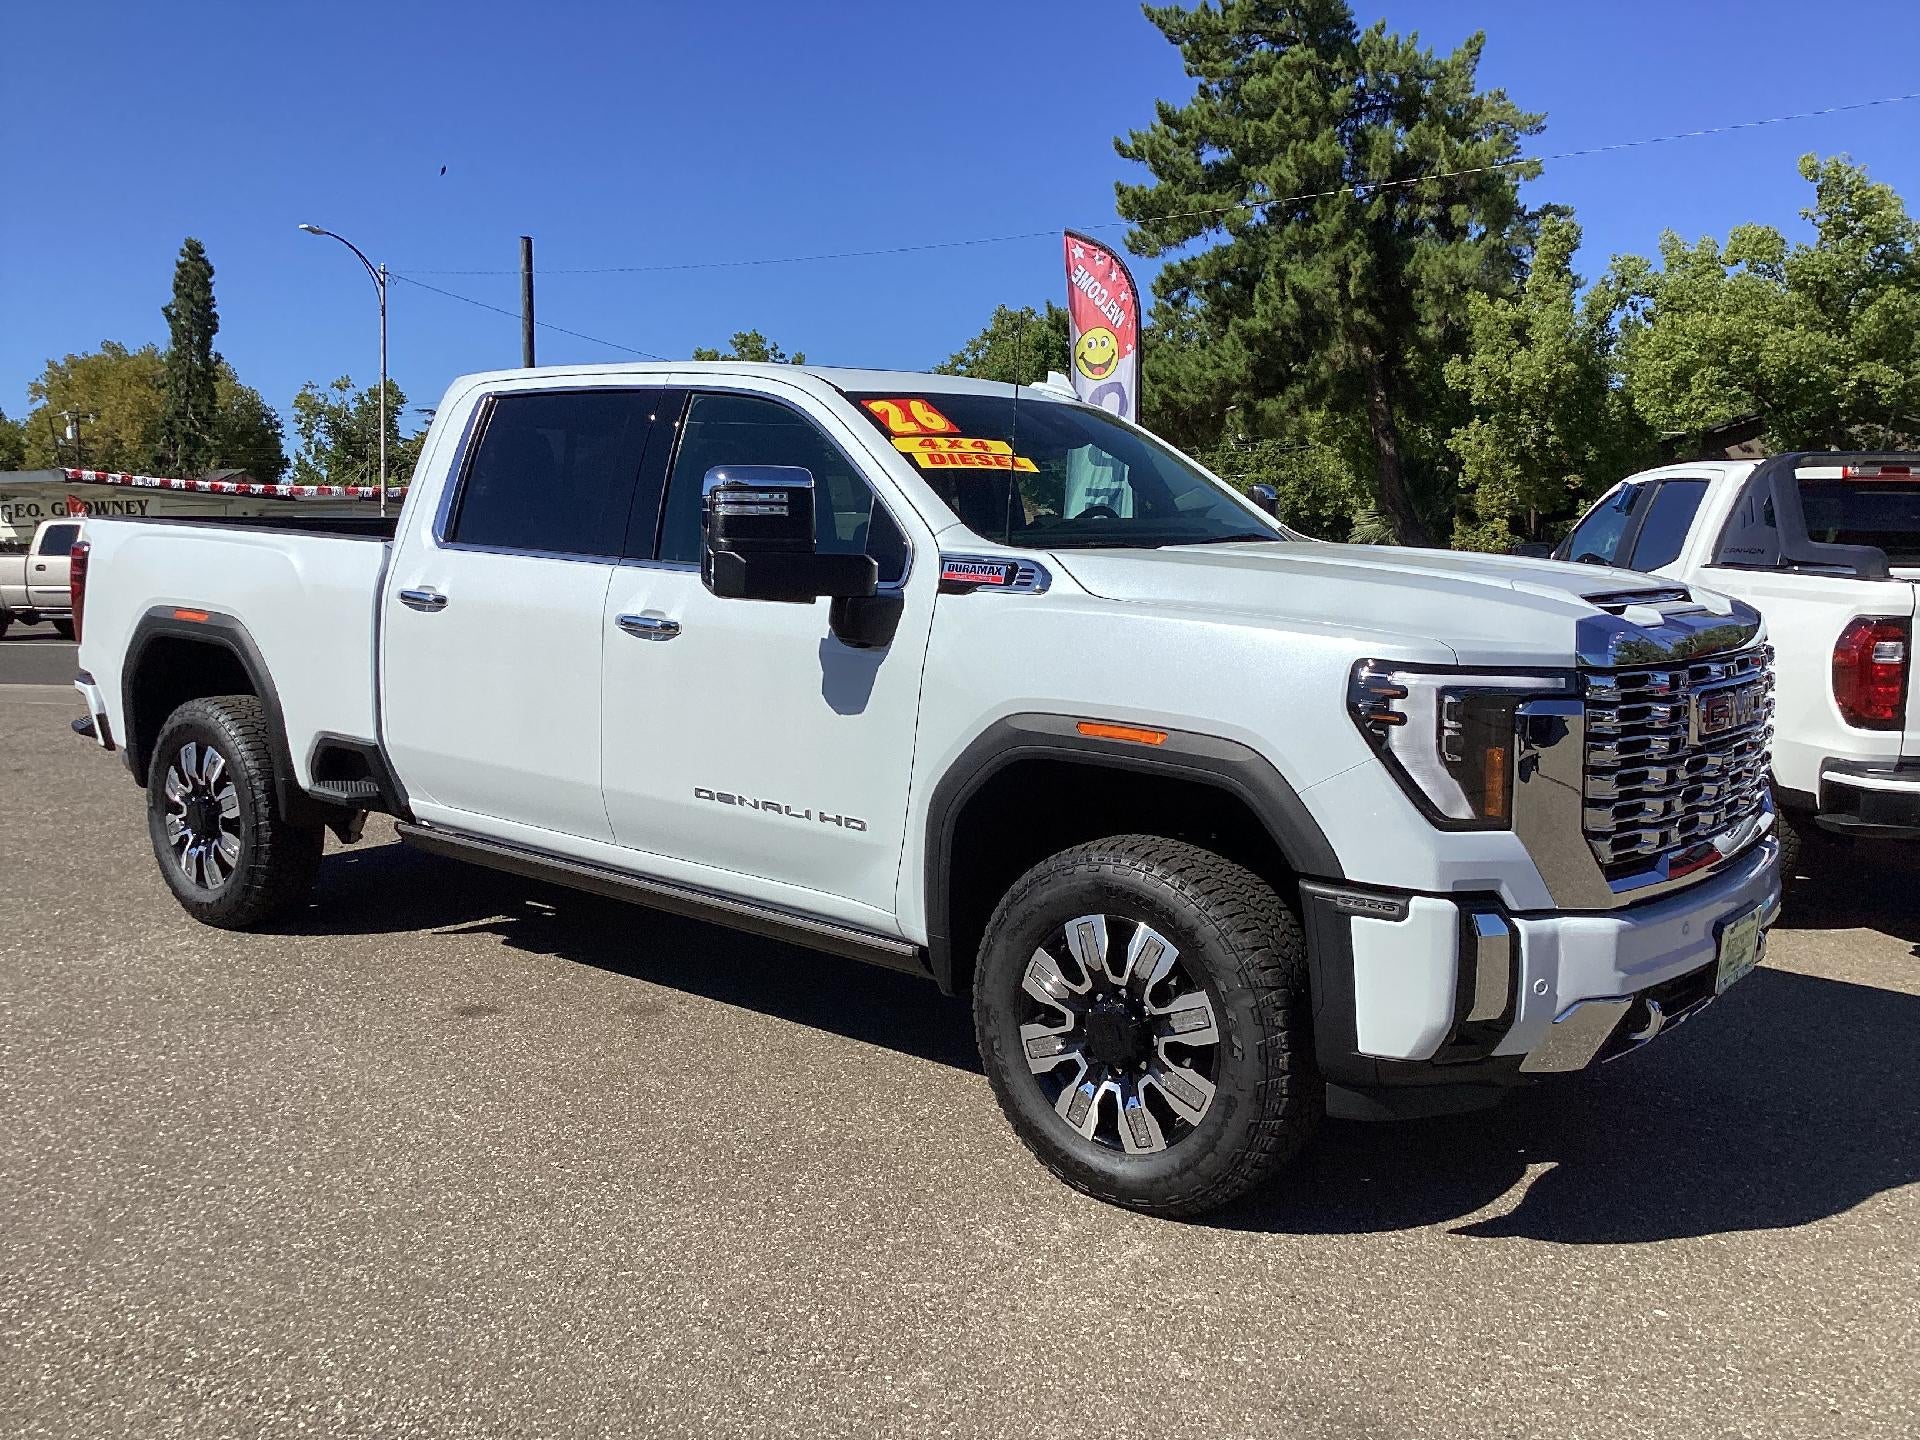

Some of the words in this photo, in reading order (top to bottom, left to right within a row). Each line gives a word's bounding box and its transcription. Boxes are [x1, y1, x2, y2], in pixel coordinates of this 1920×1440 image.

[868, 400, 951, 433] 26
[927, 453, 1028, 470] DIESEL
[0, 503, 45, 524] GEO.
[50, 499, 150, 516] GOWNEY
[1723, 547, 1765, 555] CANYON
[947, 563, 1003, 576] DURAMAX
[1699, 684, 1764, 734] GMC
[694, 787, 812, 822] DENALI
[818, 811, 867, 832] HD
